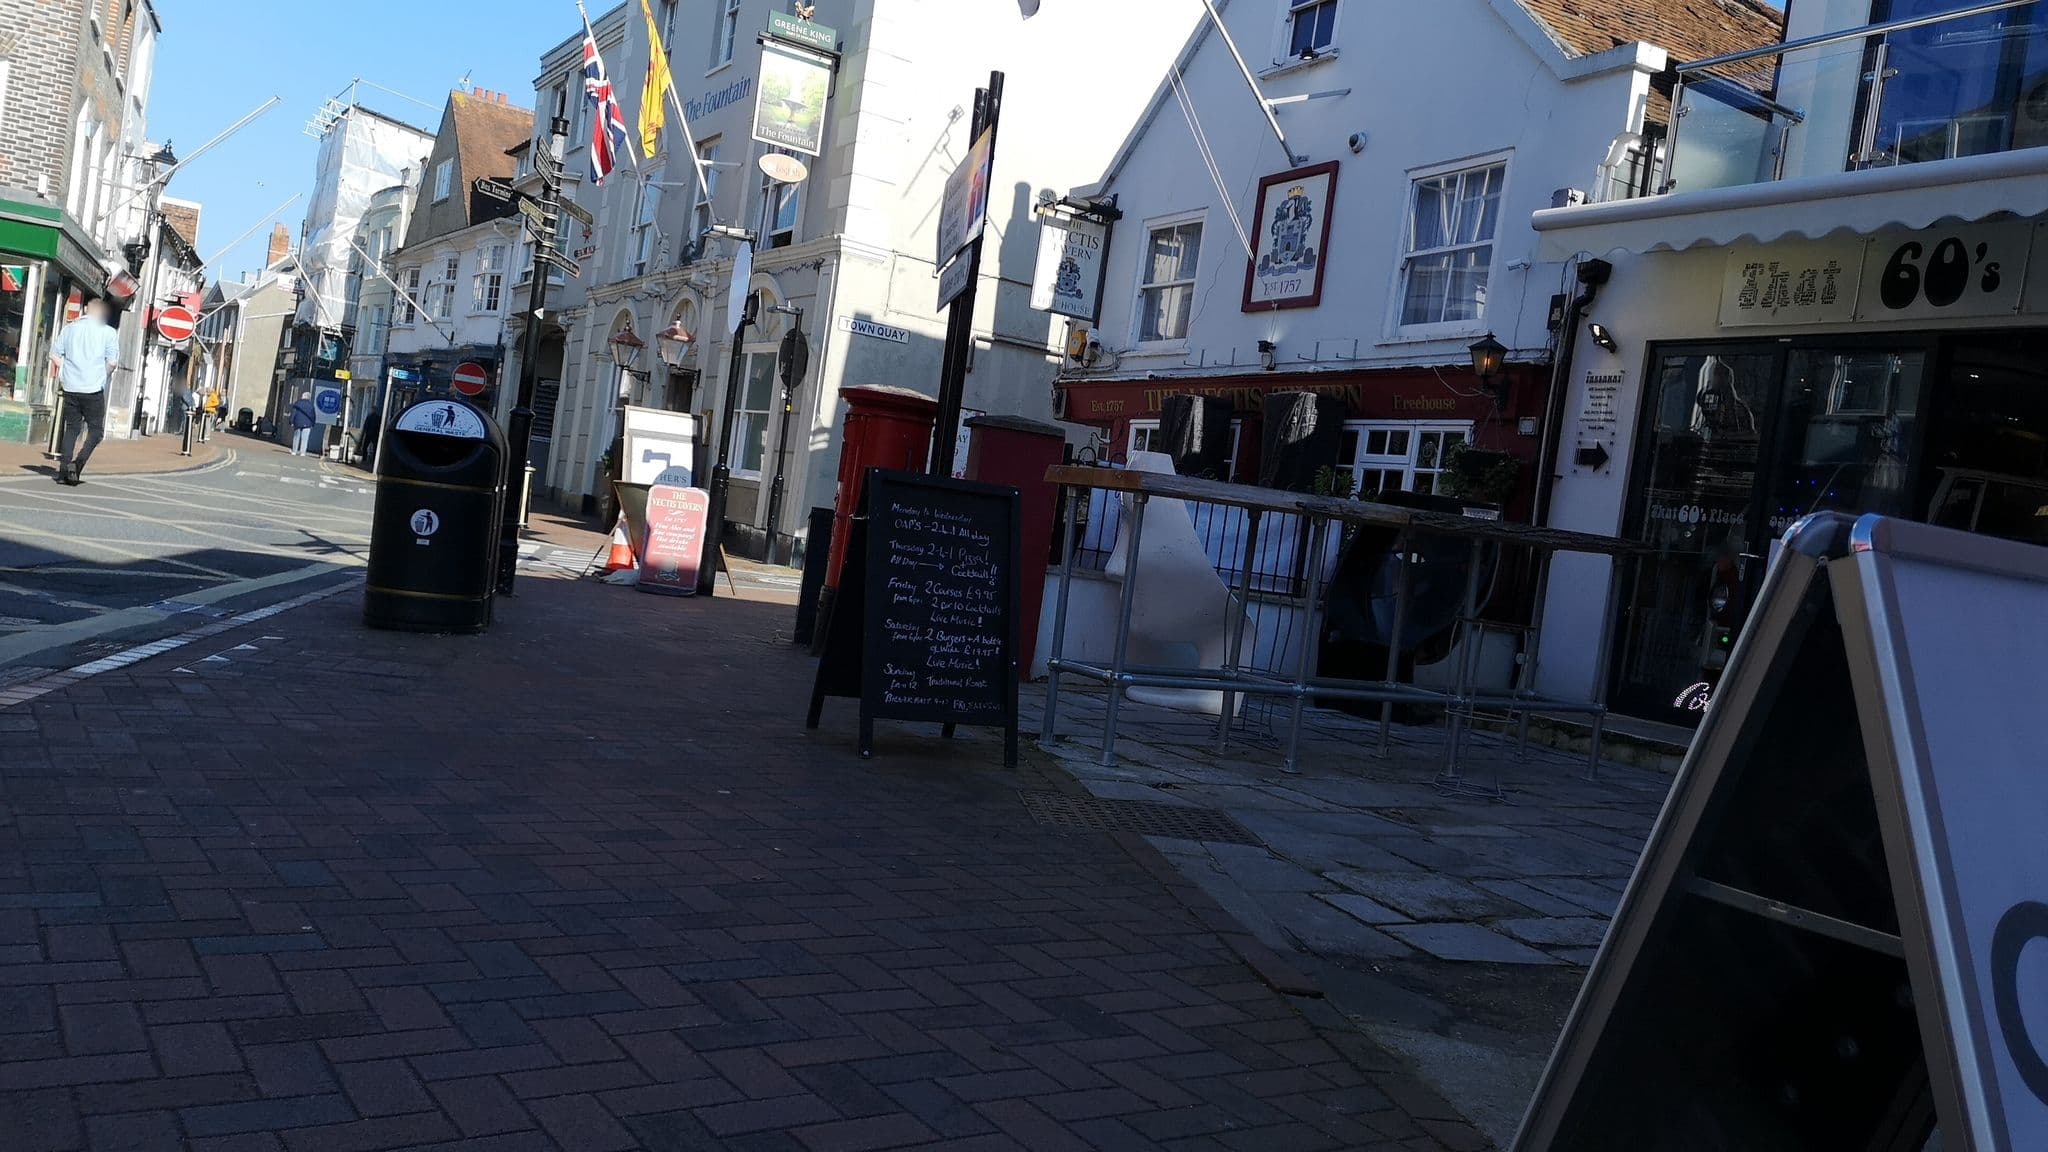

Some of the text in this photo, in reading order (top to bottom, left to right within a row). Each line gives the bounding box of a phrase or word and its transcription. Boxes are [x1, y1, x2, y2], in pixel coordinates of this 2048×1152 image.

[774, 18, 808, 35] GREENE
[809, 29, 832, 43] KING
[684, 76, 752, 123] The Fountain
[760, 126, 777, 138] The
[777, 131, 814, 149] Fountain
[1880, 236, 2001, 310] 60's
[1278, 278, 1302, 295] 1757
[844, 319, 906, 341] TOWN QUAY
[1184, 385, 1264, 412] CTIS
[1392, 394, 1457, 411] Freehouse
[414, 424, 444, 434] GENERAL
[652, 497, 679, 509] VECTIS
[671, 490, 688, 501] THE
[891, 502, 921, 517] Monday
[1678, 503, 1707, 524] 60's
[971, 529, 990, 547] day
[889, 540, 924, 556] Thursday
[887, 577, 917, 596] Friday
[953, 601, 965, 611] 10
[930, 609, 949, 624] Live
[884, 618, 921, 634] Saturday
[923, 627, 934, 641] 2
[936, 630, 967, 647] Burgers
[926, 655, 947, 668] Live
[883, 663, 917, 682] Sunday
